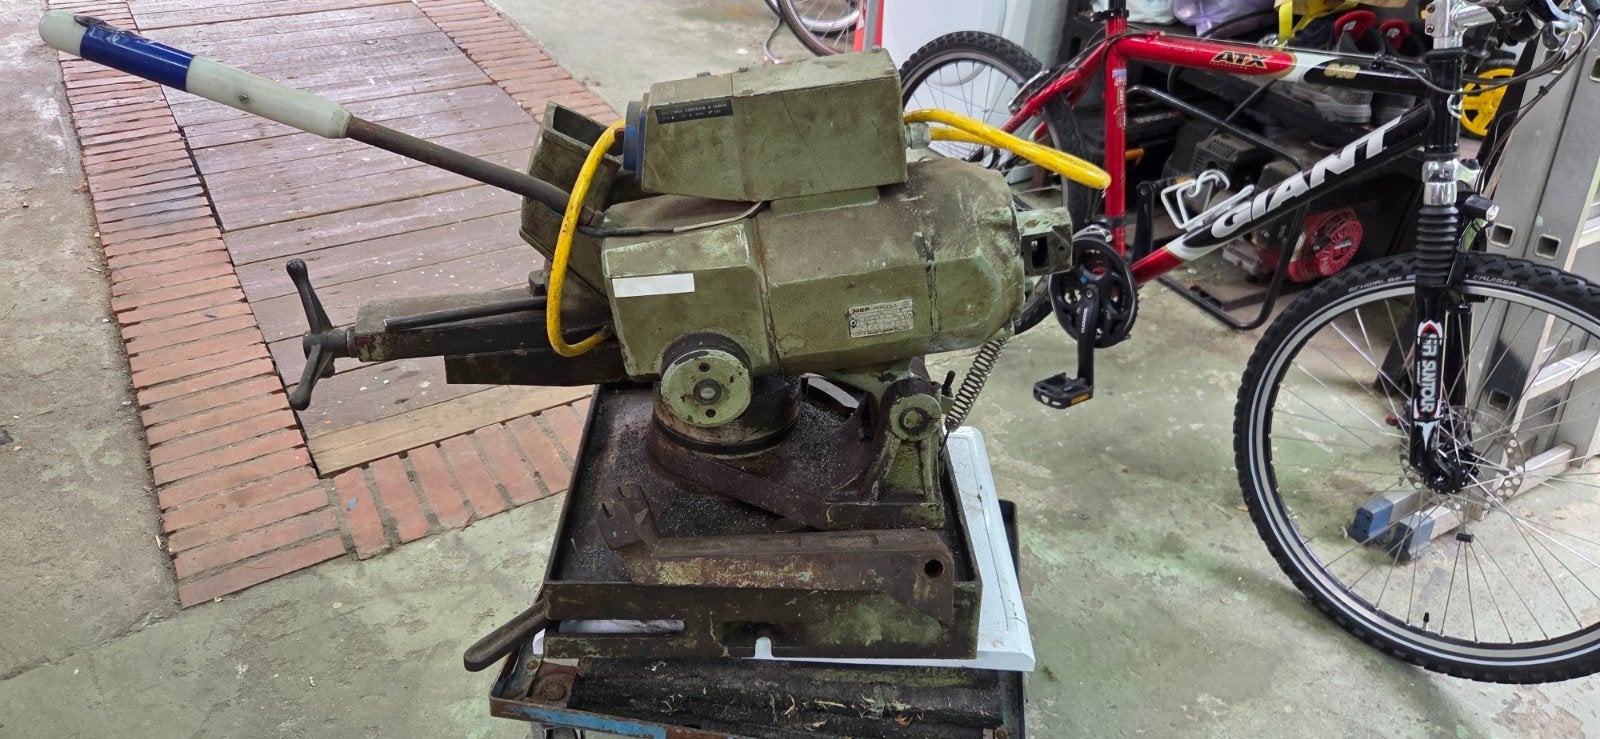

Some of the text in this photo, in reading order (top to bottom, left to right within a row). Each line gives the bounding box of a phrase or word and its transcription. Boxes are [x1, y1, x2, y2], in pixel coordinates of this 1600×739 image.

[1210, 50, 1273, 69] ATX
[1211, 115, 1402, 238] GIANT
[1420, 360, 1437, 413] SUNTOUR
